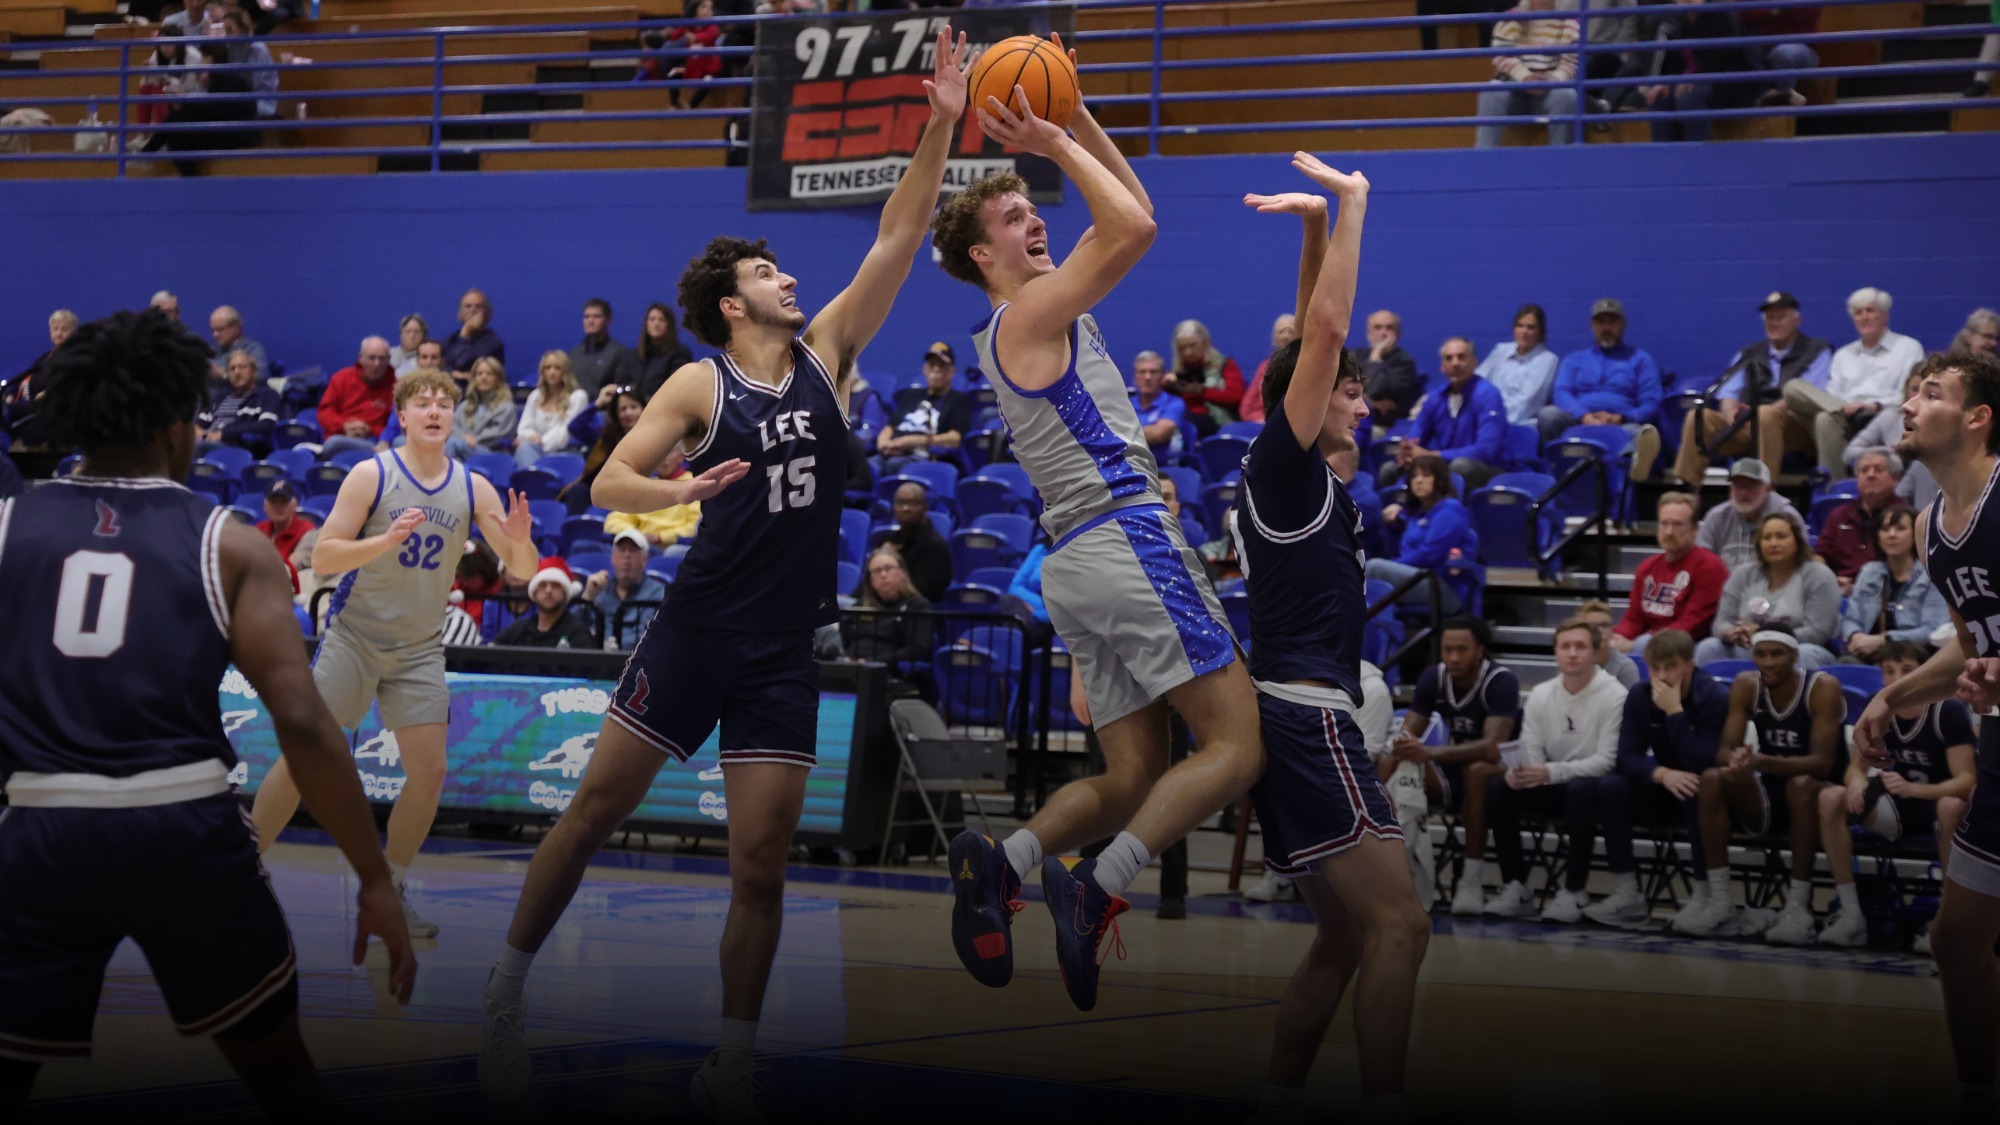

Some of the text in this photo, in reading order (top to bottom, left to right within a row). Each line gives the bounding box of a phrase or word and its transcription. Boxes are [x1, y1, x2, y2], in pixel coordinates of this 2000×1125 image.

[795, 17, 929, 80] 97.7
[757, 410, 817, 452] LEE
[766, 455, 816, 513] 15
[399, 532, 444, 570] 32
[53, 549, 135, 658] 0
[1945, 566, 2000, 609] LEE
[540, 687, 612, 717] TURB
